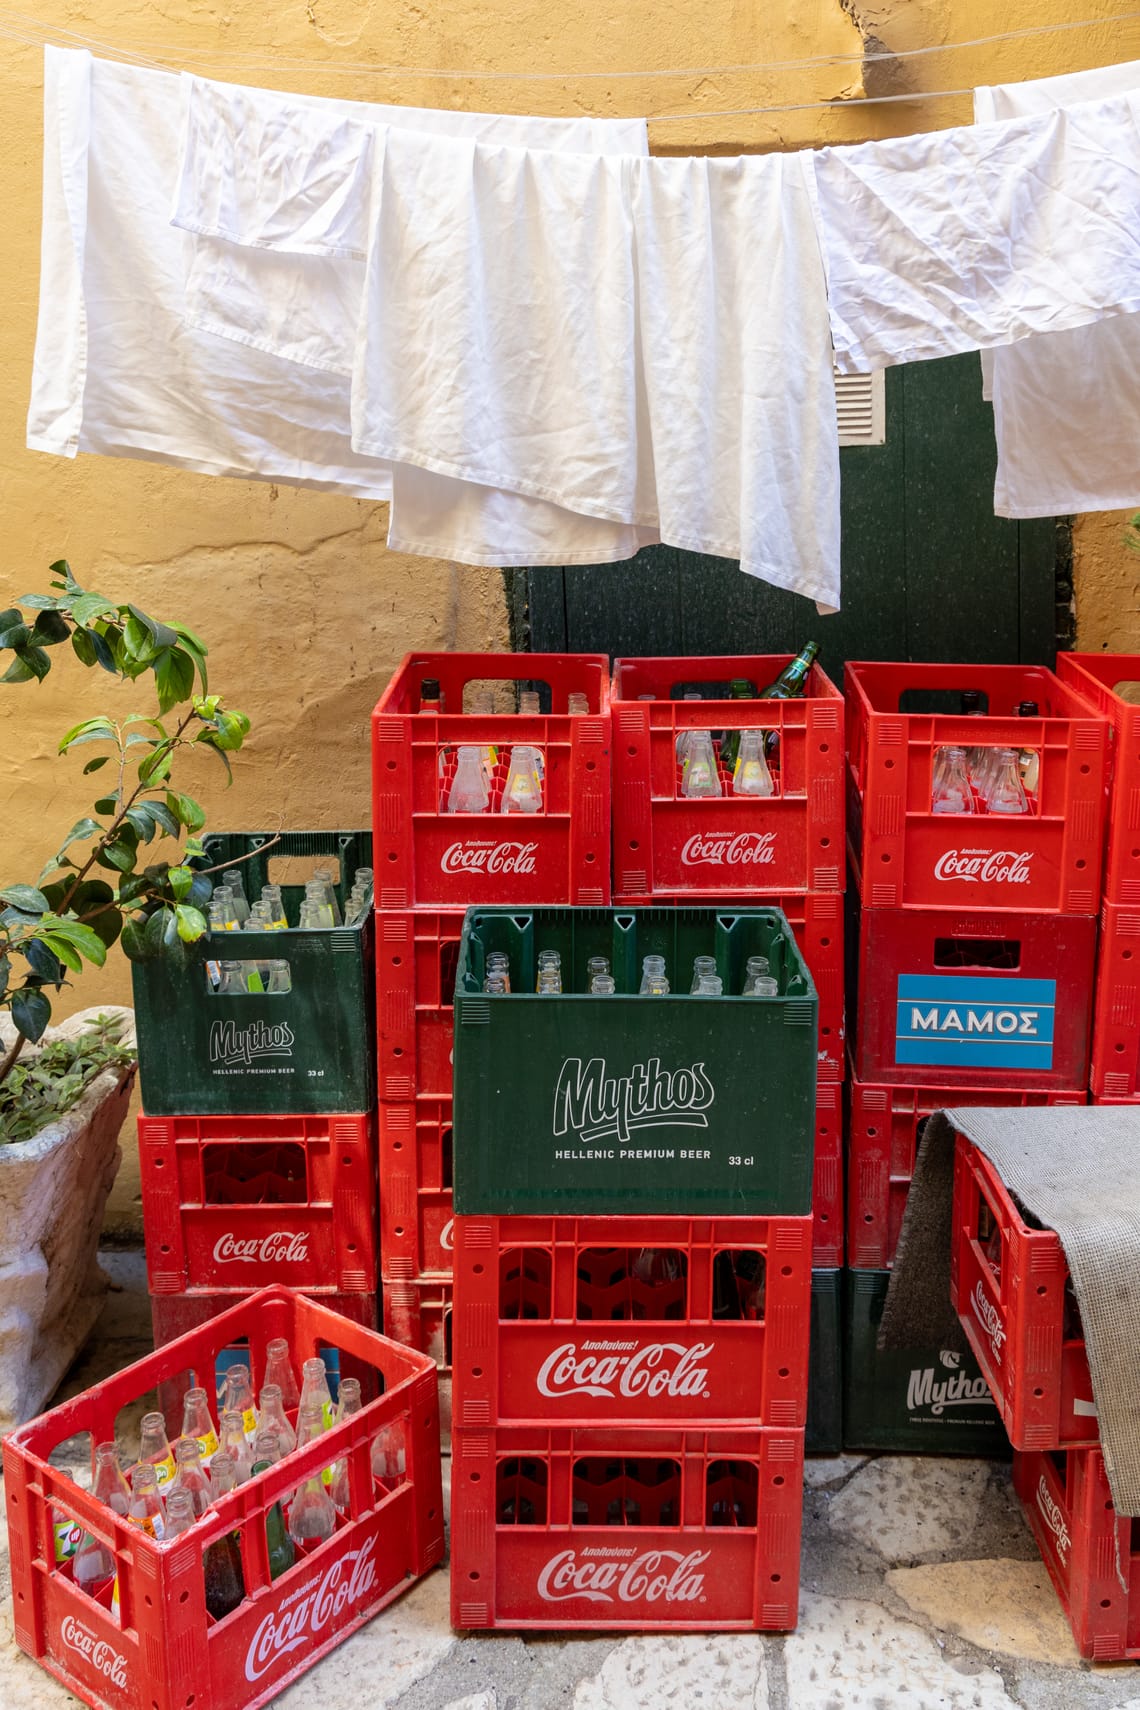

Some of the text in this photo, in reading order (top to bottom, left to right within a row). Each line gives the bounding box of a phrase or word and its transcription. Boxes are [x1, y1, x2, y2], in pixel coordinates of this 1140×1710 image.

[441, 842, 539, 874] Coca-Cola
[681, 832, 778, 866] Coca-Cola
[934, 849, 1034, 882] Coca-Cola
[209, 1020, 295, 1065] Mythos
[911, 1007, 1039, 1034] ΜΑΜΟΣ
[552, 1057, 715, 1142] Mythos
[555, 1149, 712, 1160] HELLENIC PREMIUM BEER
[728, 1156, 754, 1166] 33 cl
[213, 1231, 310, 1263] Coca-Cola
[537, 1343, 715, 1398] Coca-Cola
[906, 1367, 993, 1416] Mytho
[1036, 1474, 1072, 1551] Coca-Cola
[537, 1549, 712, 1602] Coca-Cola
[245, 1530, 380, 1682] Coca-Cola
[61, 1615, 128, 1689] Coca-Cola
